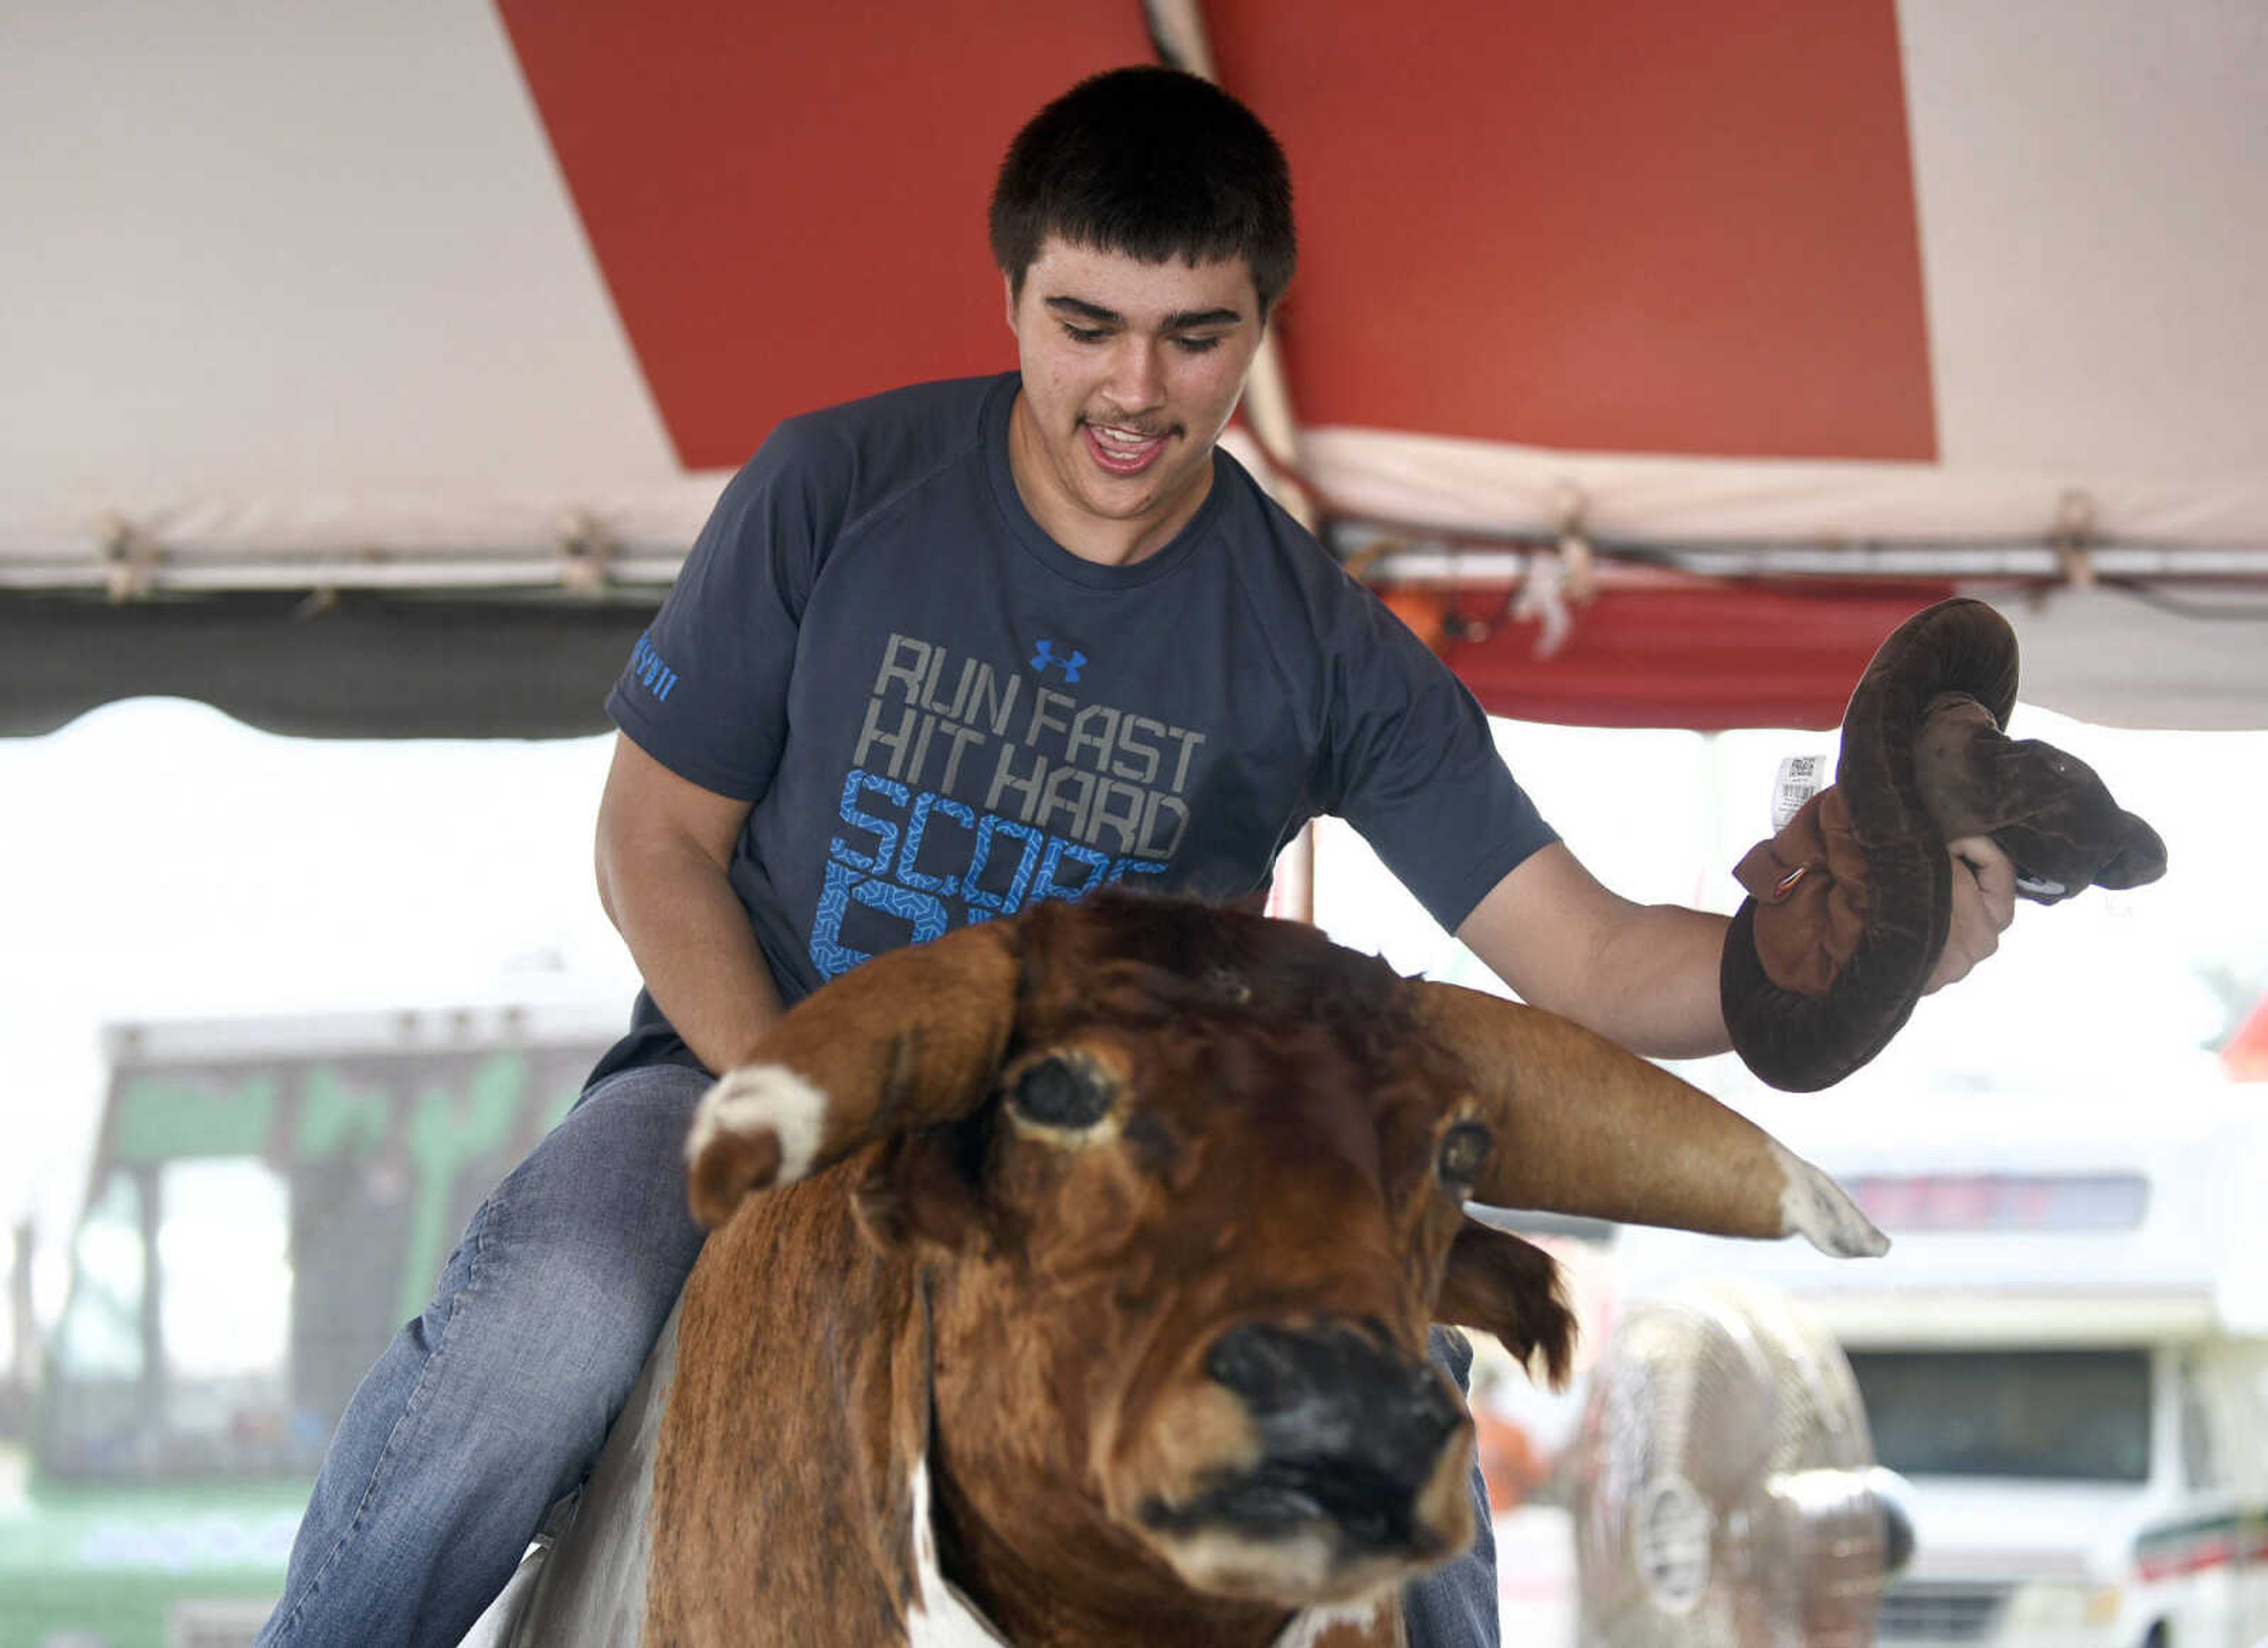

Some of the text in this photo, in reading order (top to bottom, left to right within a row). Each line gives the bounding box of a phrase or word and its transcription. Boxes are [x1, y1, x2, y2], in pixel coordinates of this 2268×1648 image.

[853, 698, 1191, 859] HIT HARD
[874, 633, 1206, 793] RUN FAST
